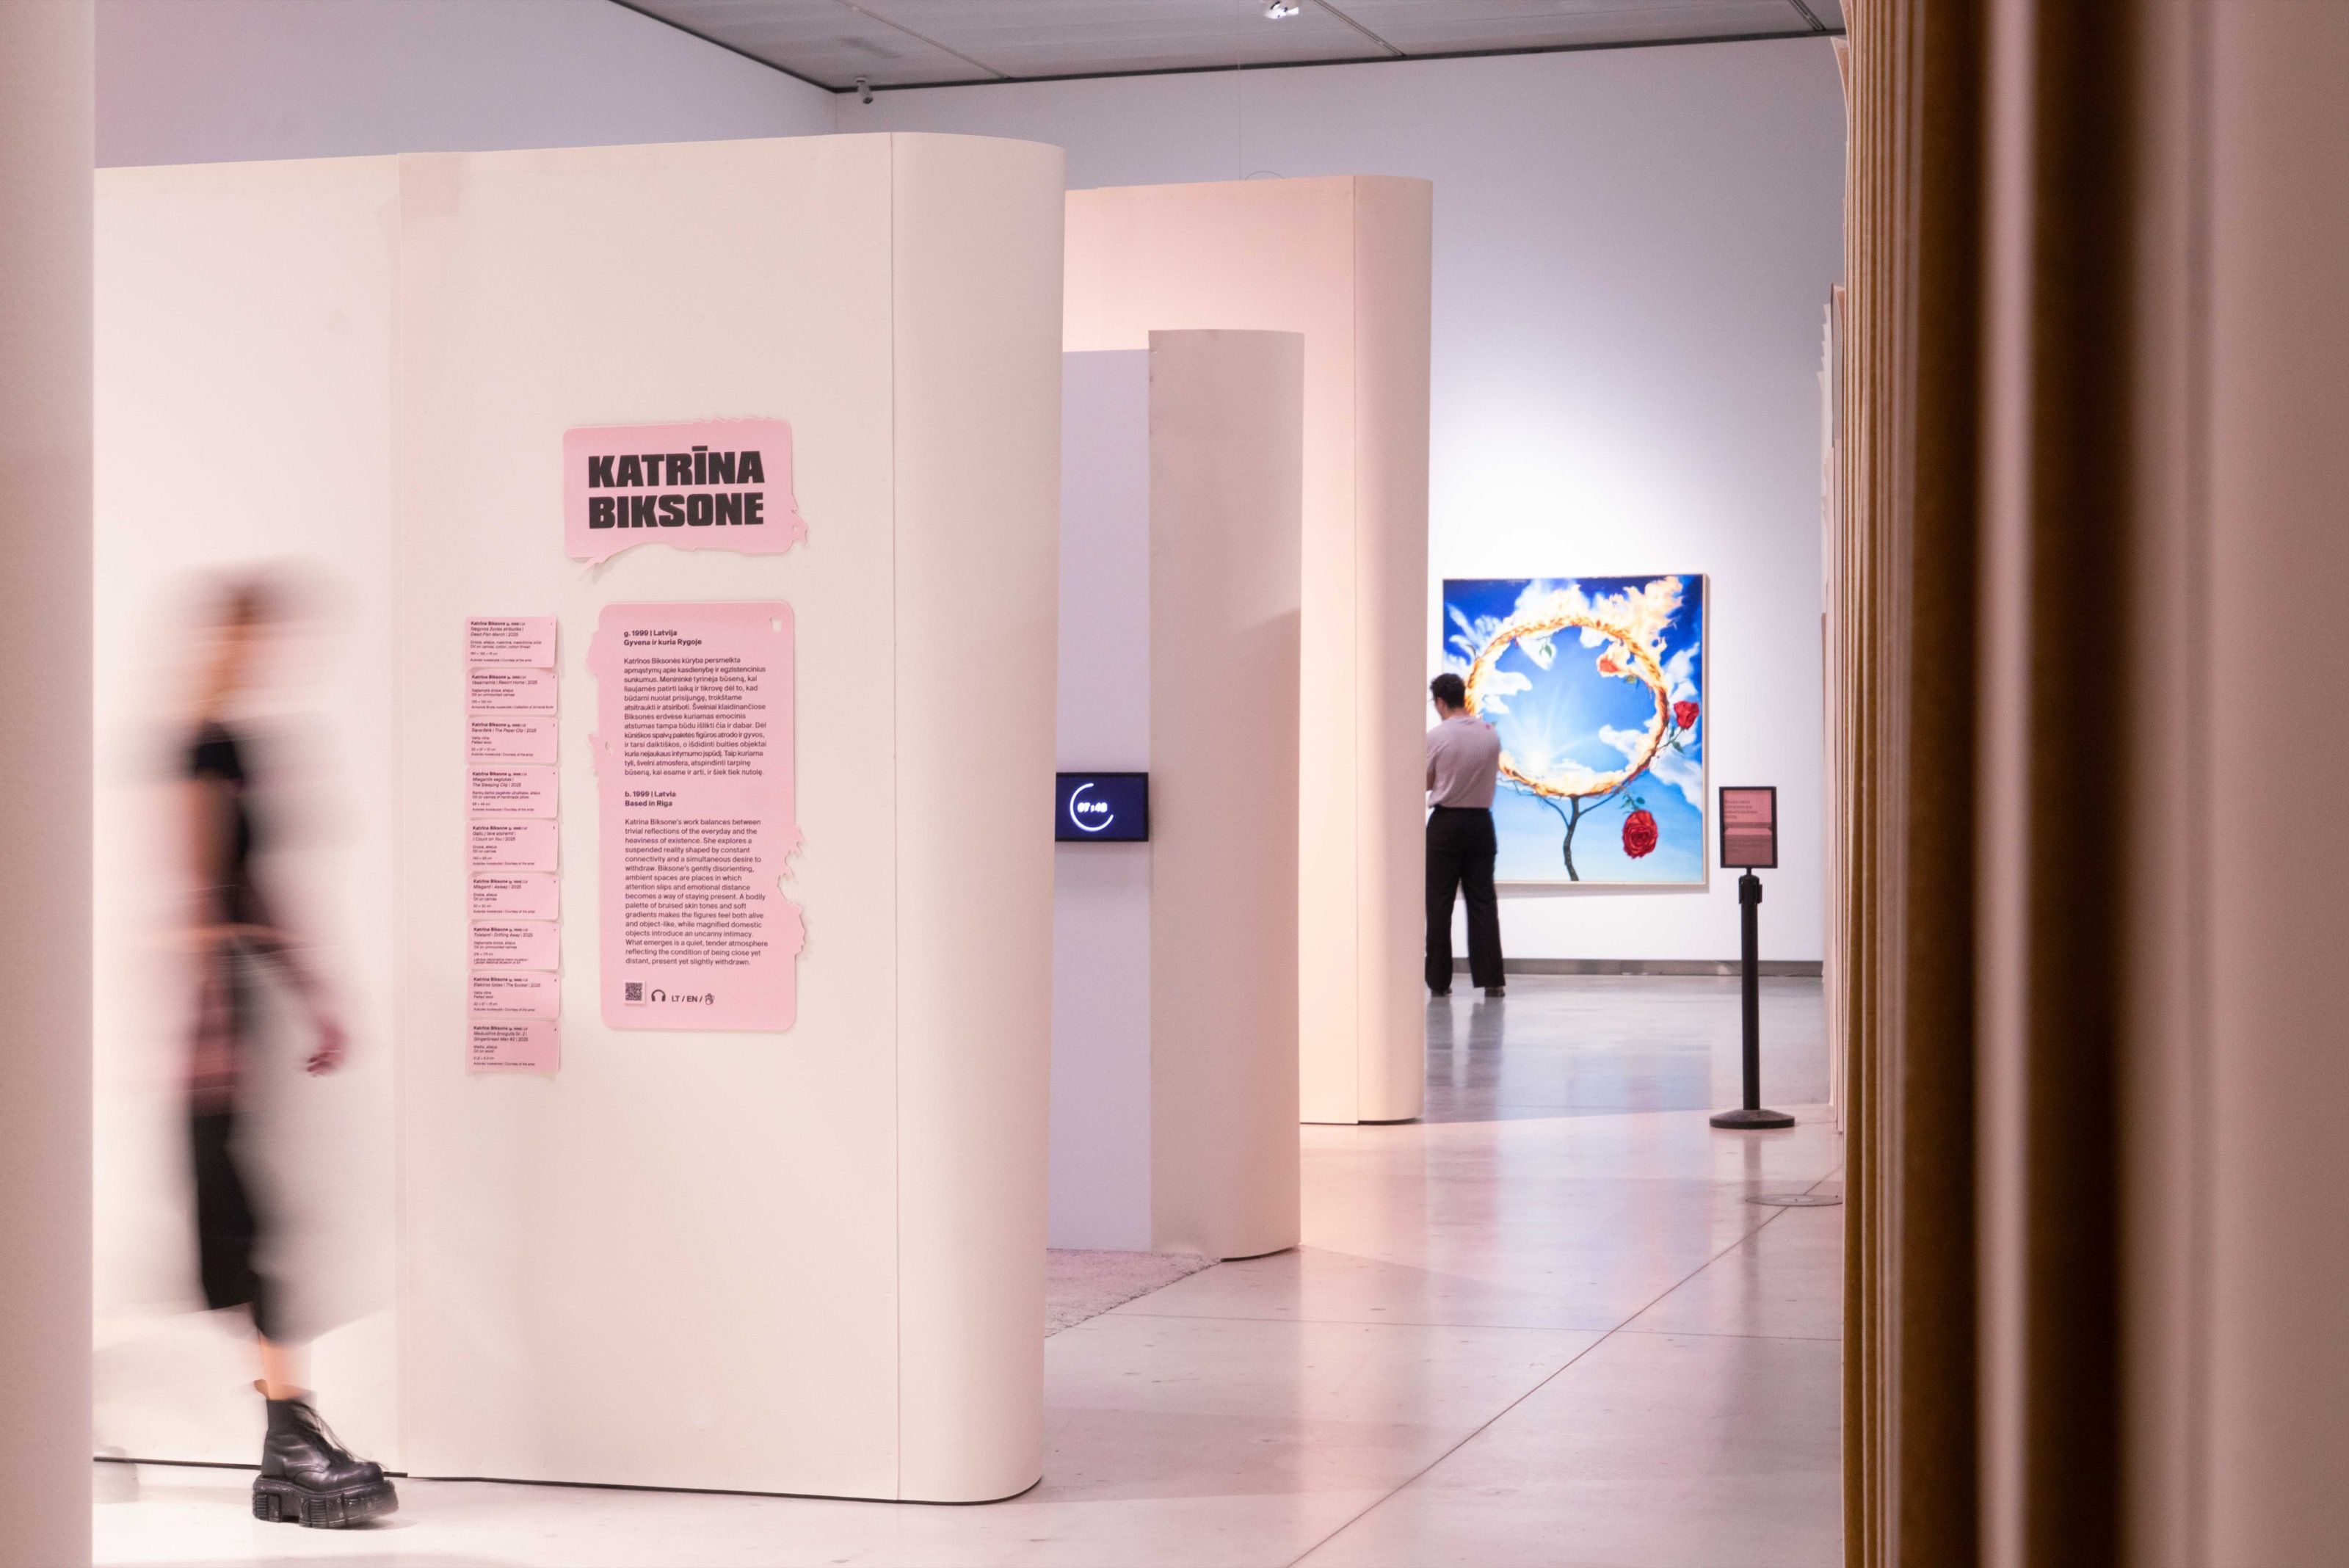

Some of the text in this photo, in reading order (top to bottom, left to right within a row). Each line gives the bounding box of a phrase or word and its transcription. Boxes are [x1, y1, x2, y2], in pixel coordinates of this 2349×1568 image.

[588, 445, 765, 488] KATRĪNA
[589, 492, 764, 529] BIKSONE
[656, 800, 672, 808] Riga
[702, 828, 730, 836] everyday
[625, 846, 662, 854] suspended
[664, 846, 683, 854] reality
[686, 846, 710, 854] shaped
[711, 846, 719, 854] by
[625, 856, 665, 864] connectivity
[691, 874, 714, 882] places
[657, 884, 672, 892] slips
[746, 893, 766, 901] bodily
[625, 902, 648, 910] palette
[694, 912, 716, 920] figures
[697, 921, 729, 929] magnified
[625, 930, 650, 938] objects
[625, 948, 657, 957] reflecting
[711, 949, 730, 957] being
[652, 958, 677, 966] present
[679, 958, 688, 966] yet
